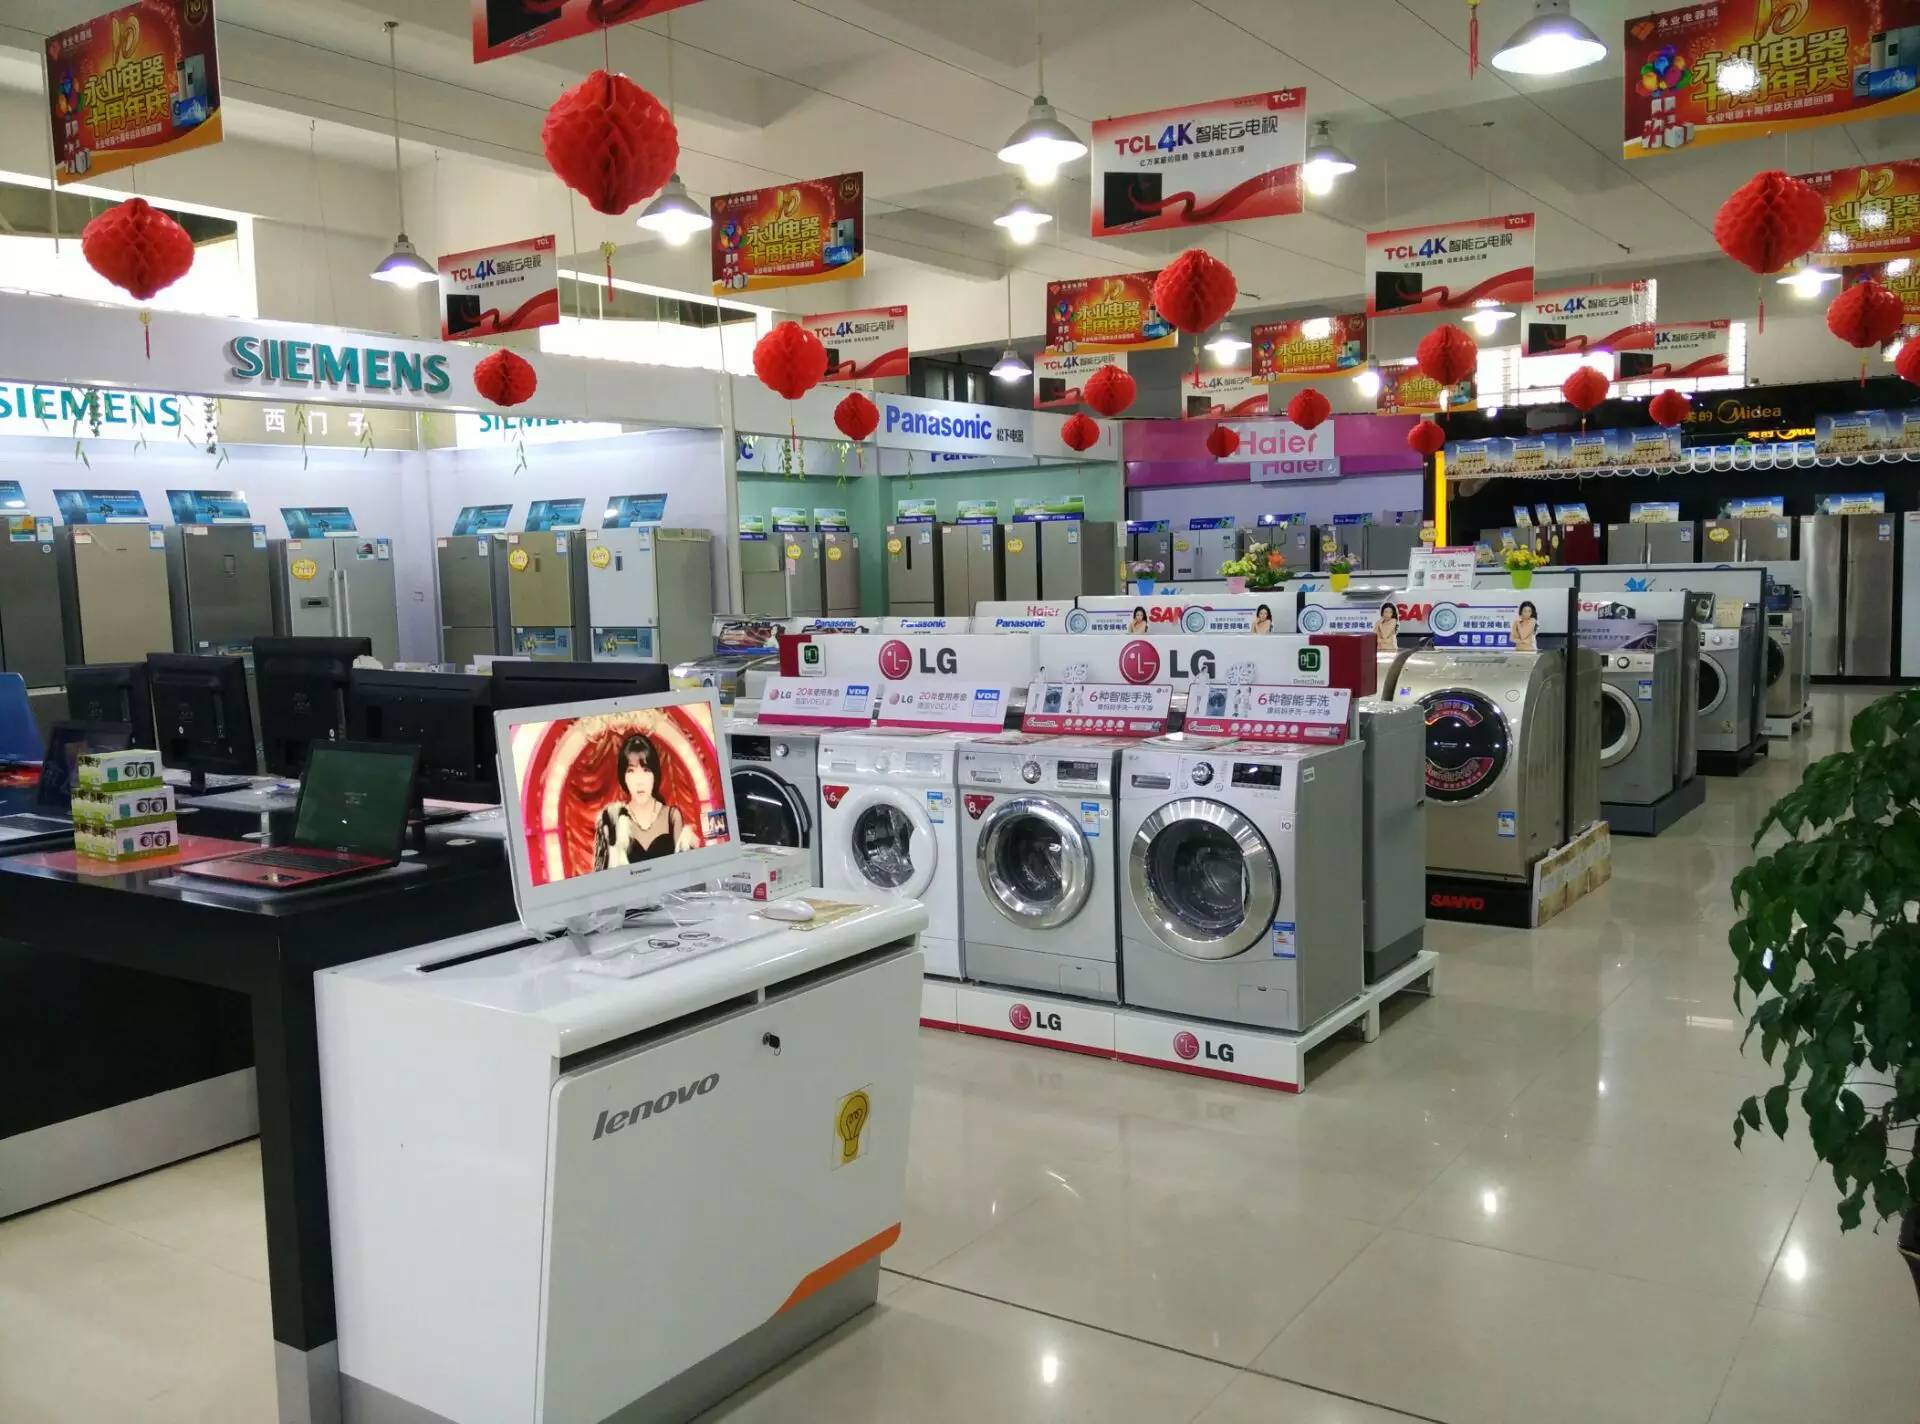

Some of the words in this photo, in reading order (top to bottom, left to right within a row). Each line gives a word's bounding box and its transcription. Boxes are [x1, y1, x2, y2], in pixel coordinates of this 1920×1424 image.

[84, 55, 165, 106] 永业电器
[1272, 92, 1296, 103] TCL
[86, 90, 169, 137] 十周年庆
[747, 216, 821, 246] 永业电器
[1508, 217, 1527, 226] TCL
[748, 239, 821, 265] 十周年庆
[1077, 300, 1140, 321] 永业电器
[231, 334, 451, 395] SIEMENS
[262, 408, 370, 436] 西门子
[886, 405, 992, 440] Panasonic
[996, 428, 1024, 444] 松下电器
[1731, 405, 1782, 422] Midea
[1236, 428, 1319, 456] Haier
[814, 618, 857, 630] Panasonic
[900, 618, 946, 630] Panasonic
[995, 617, 1045, 630] Panasonic
[919, 647, 958, 675] LG
[1169, 649, 1216, 679] LG
[780, 691, 792, 699] LG
[901, 695, 913, 704] LG
[1089, 691, 1153, 703] 6种智能手洗
[1257, 693, 1330, 708] 6种智能手洗
[1036, 1011, 1062, 1031] LG
[1205, 1040, 1234, 1063] LG
[592, 1072, 720, 1141] lenovo
